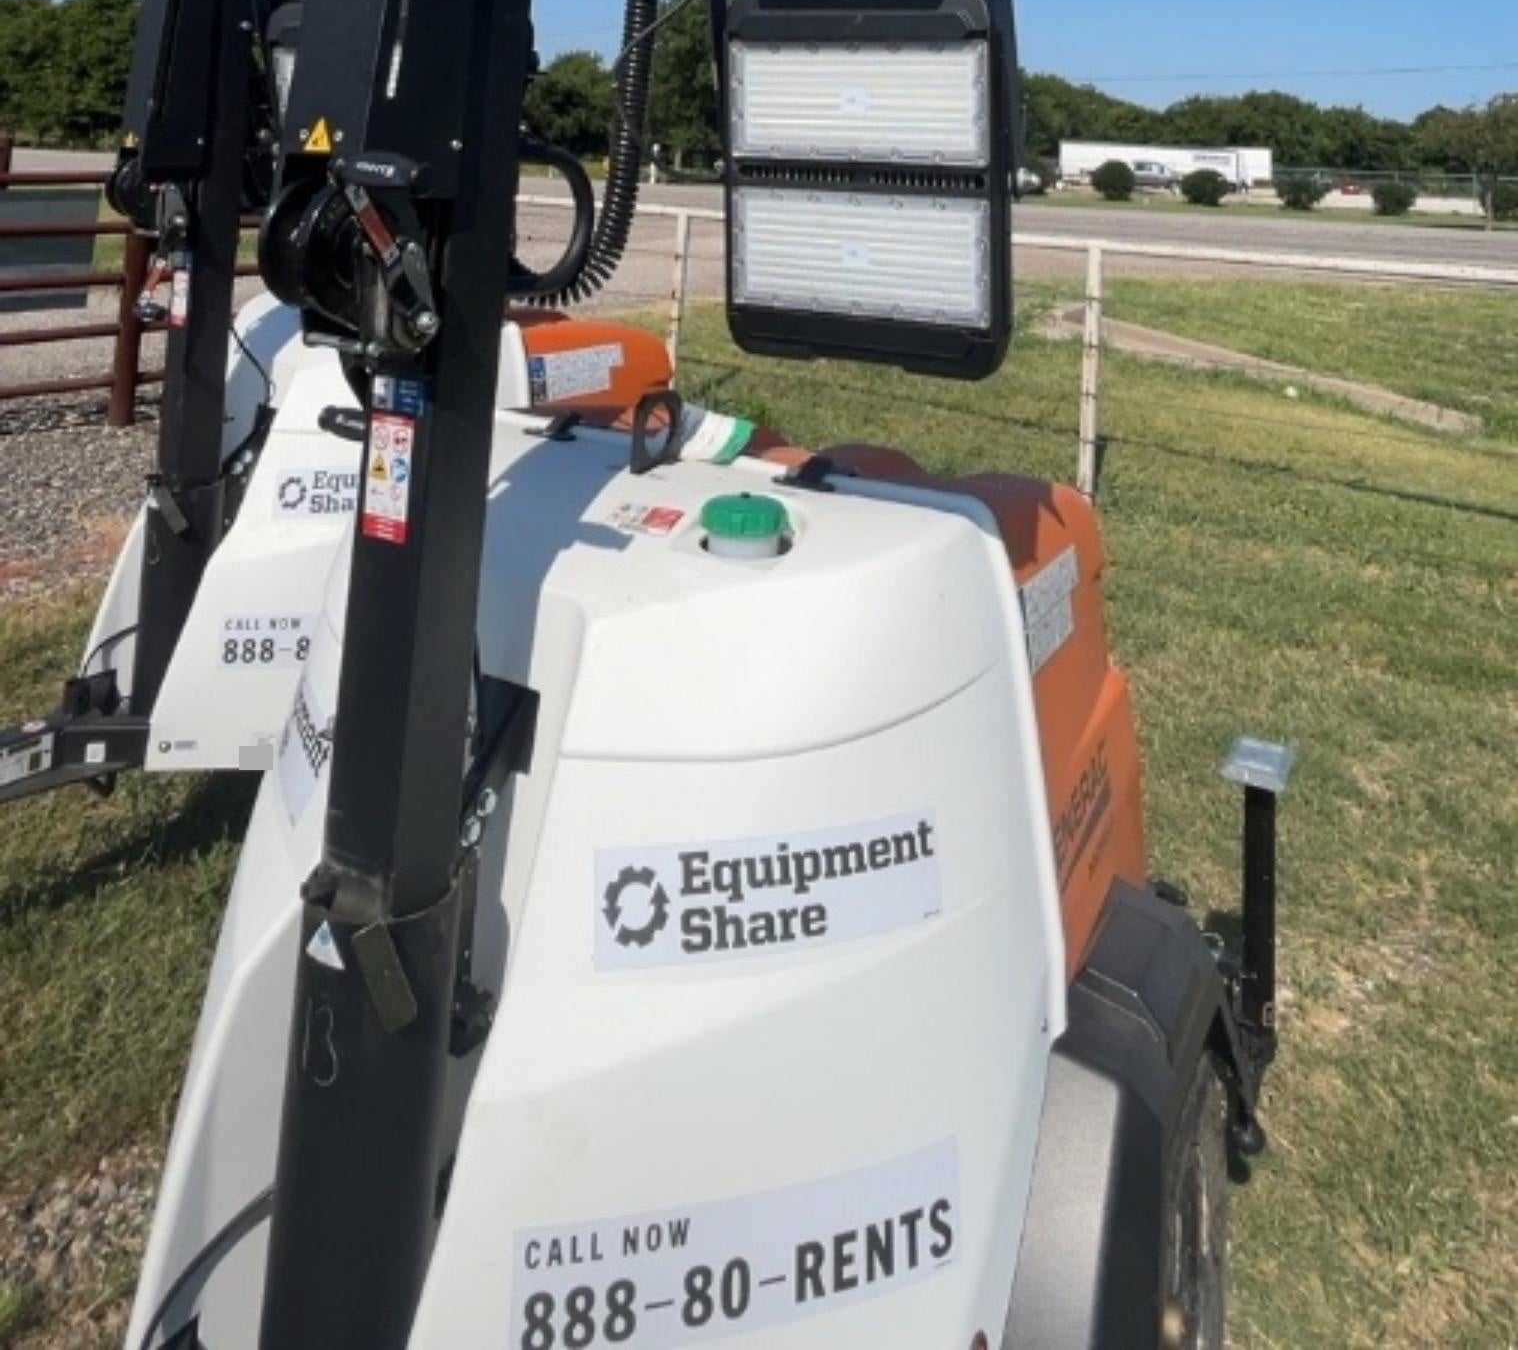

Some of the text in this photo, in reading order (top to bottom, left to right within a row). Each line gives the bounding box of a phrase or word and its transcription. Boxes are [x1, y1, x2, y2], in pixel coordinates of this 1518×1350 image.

[311, 470, 357, 492] Equ
[310, 494, 355, 513] Sha
[224, 617, 260, 631] CALL
[223, 635, 310, 664] 888-8
[677, 818, 934, 903] Equipment
[680, 903, 828, 953] Share
[524, 1217, 692, 1270] CALL NOW
[520, 1197, 954, 1350] 888-80-RENTS
